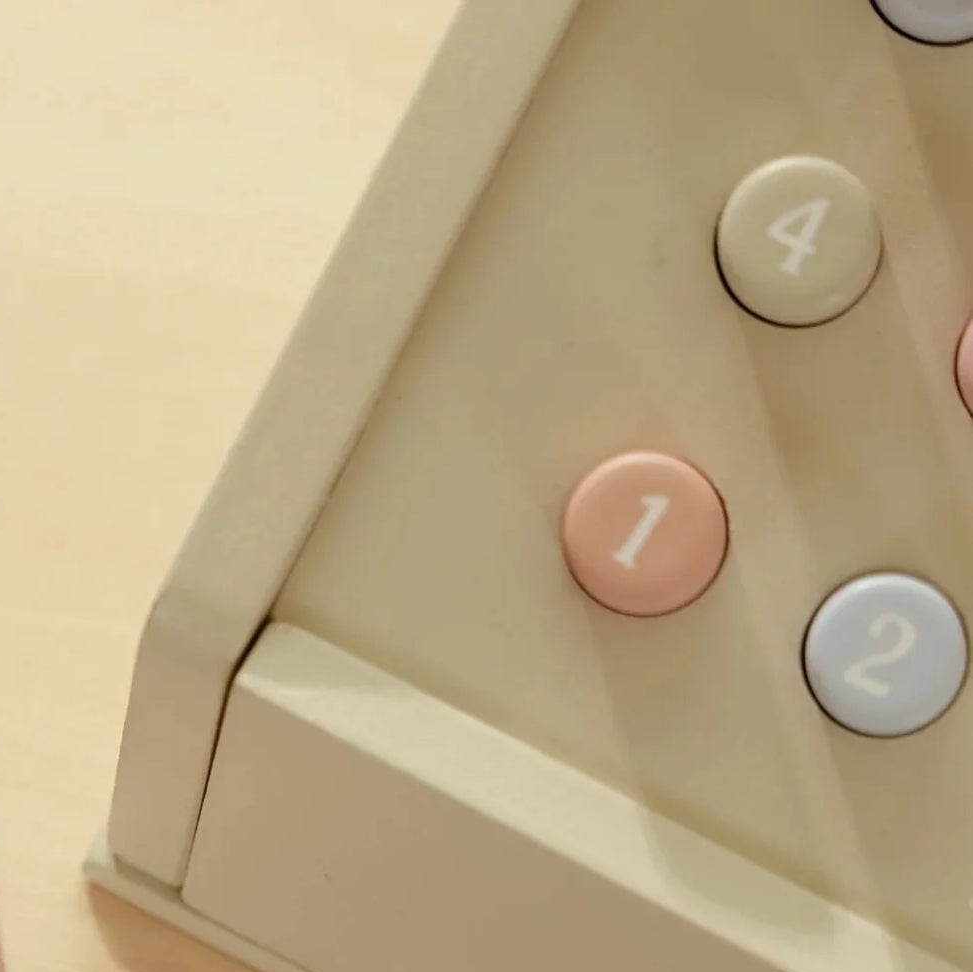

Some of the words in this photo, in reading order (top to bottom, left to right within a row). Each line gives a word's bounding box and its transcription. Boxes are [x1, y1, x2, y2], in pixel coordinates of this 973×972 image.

[766, 197, 830, 277] 4
[612, 494, 670, 570] 1
[843, 611, 917, 698] 2
